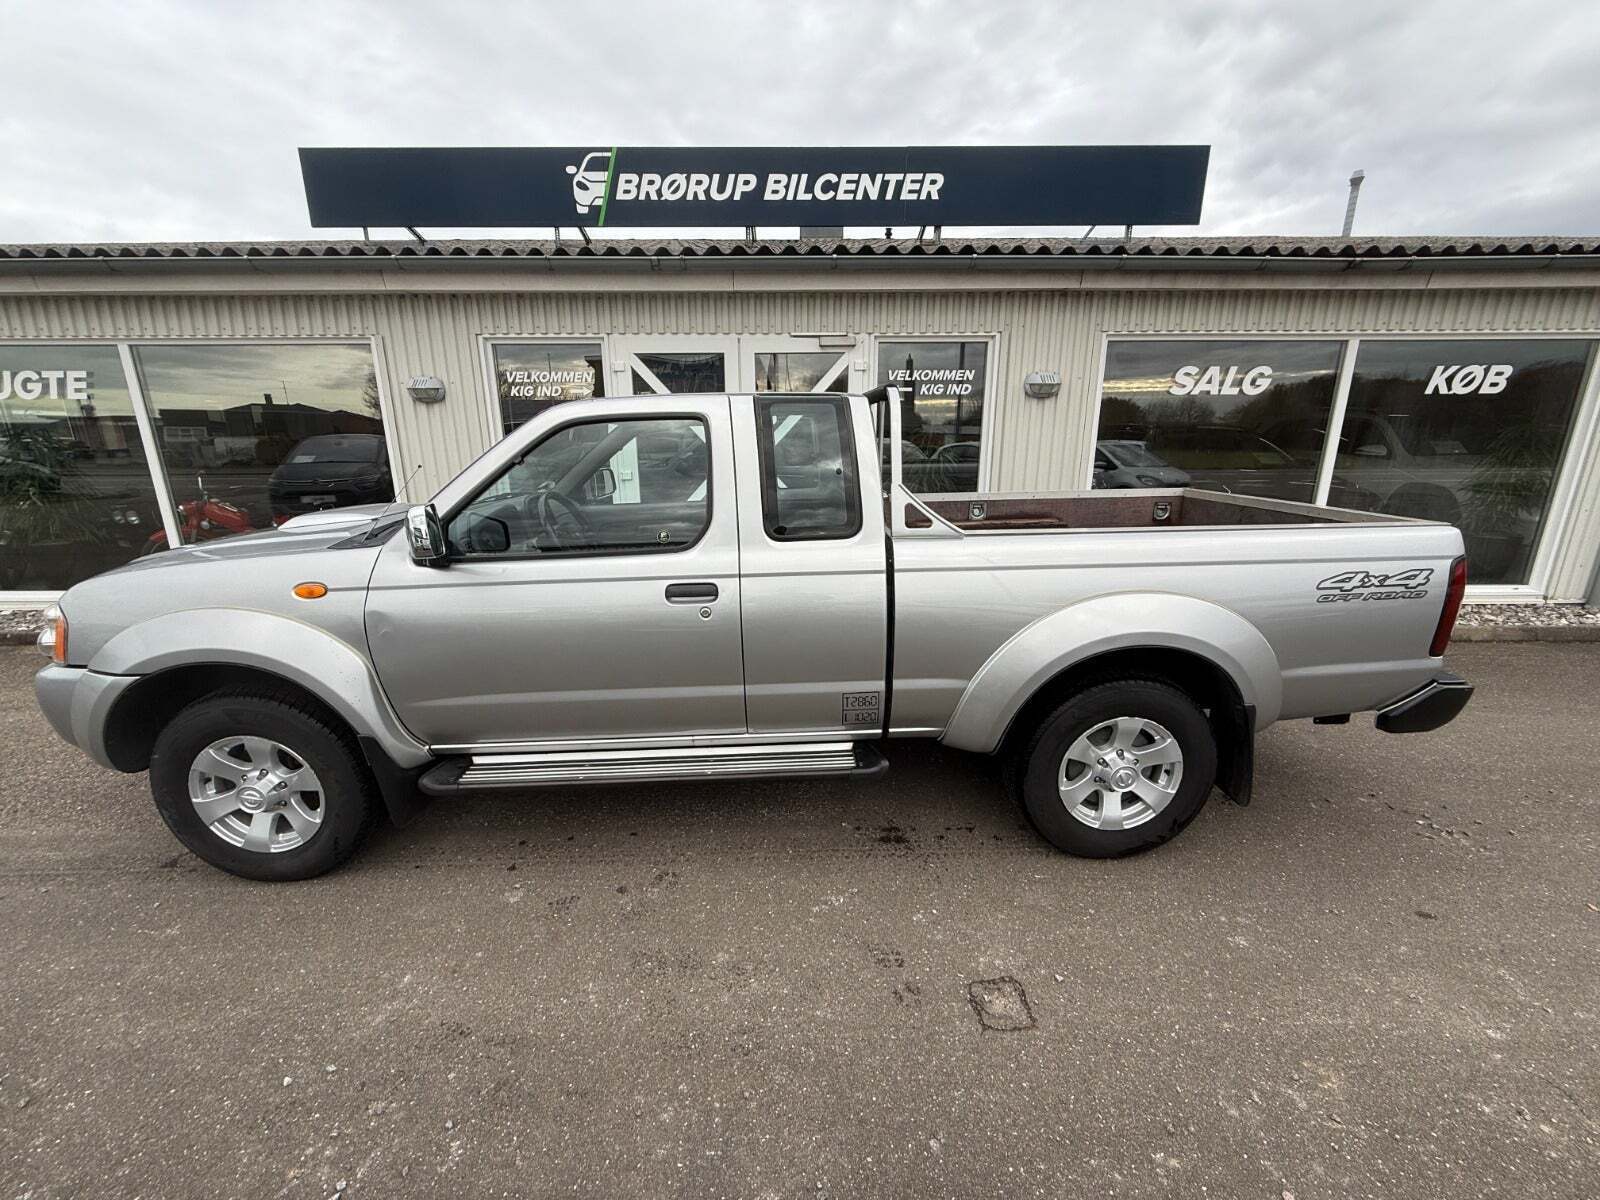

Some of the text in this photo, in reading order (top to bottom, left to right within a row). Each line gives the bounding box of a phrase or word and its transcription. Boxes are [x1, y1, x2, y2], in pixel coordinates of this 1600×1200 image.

[615, 172, 944, 200] BRØRUP BILCENTER
[506, 371, 593, 383] VELKOMMEN
[887, 369, 975, 381] VELKOMMEN
[1168, 365, 1273, 396] SALG
[1424, 364, 1513, 395] KØB
[510, 385, 562, 397] KIG IND
[919, 383, 972, 395] KIG IND
[1316, 568, 1434, 592] 4x4
[1316, 590, 1428, 603] OFF ROAD
